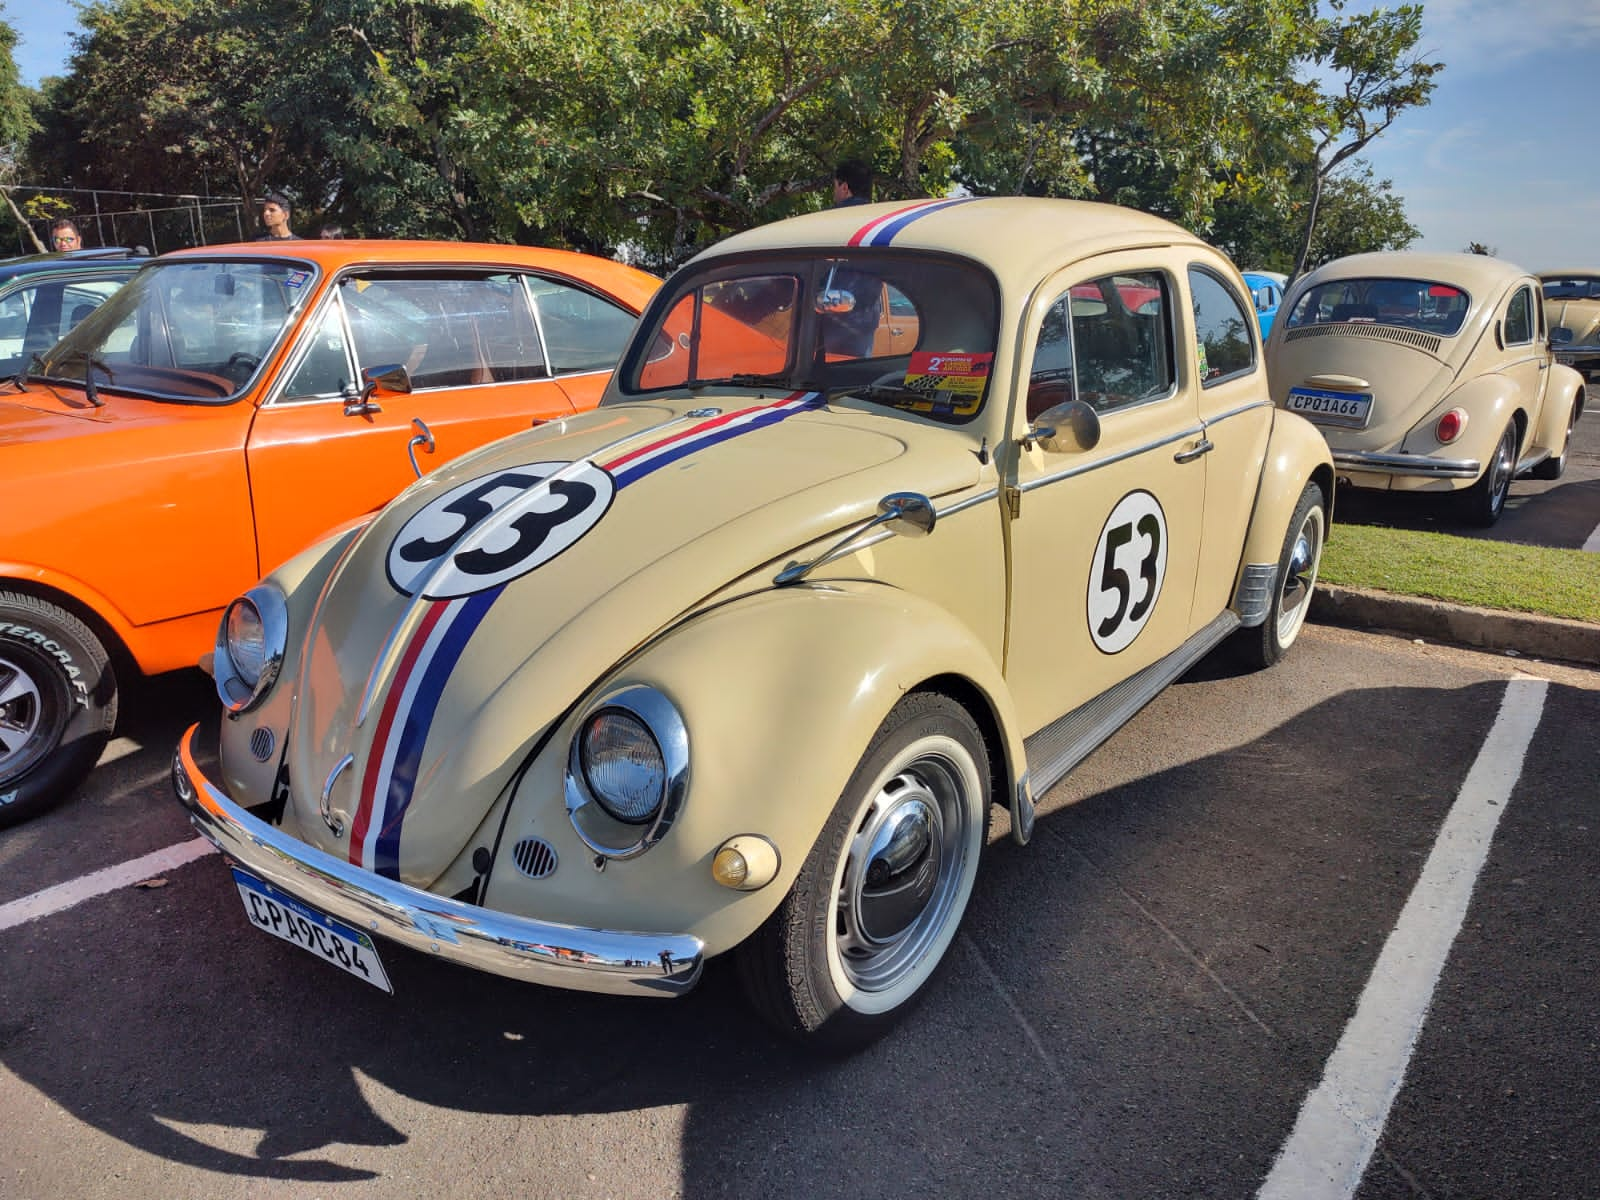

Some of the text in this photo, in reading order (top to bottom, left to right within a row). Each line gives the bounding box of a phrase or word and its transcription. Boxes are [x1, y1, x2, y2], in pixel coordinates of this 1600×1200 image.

[399, 472, 598, 575] 53
[1097, 513, 1161, 638] 53
[249, 892, 370, 977] CPA9C84
